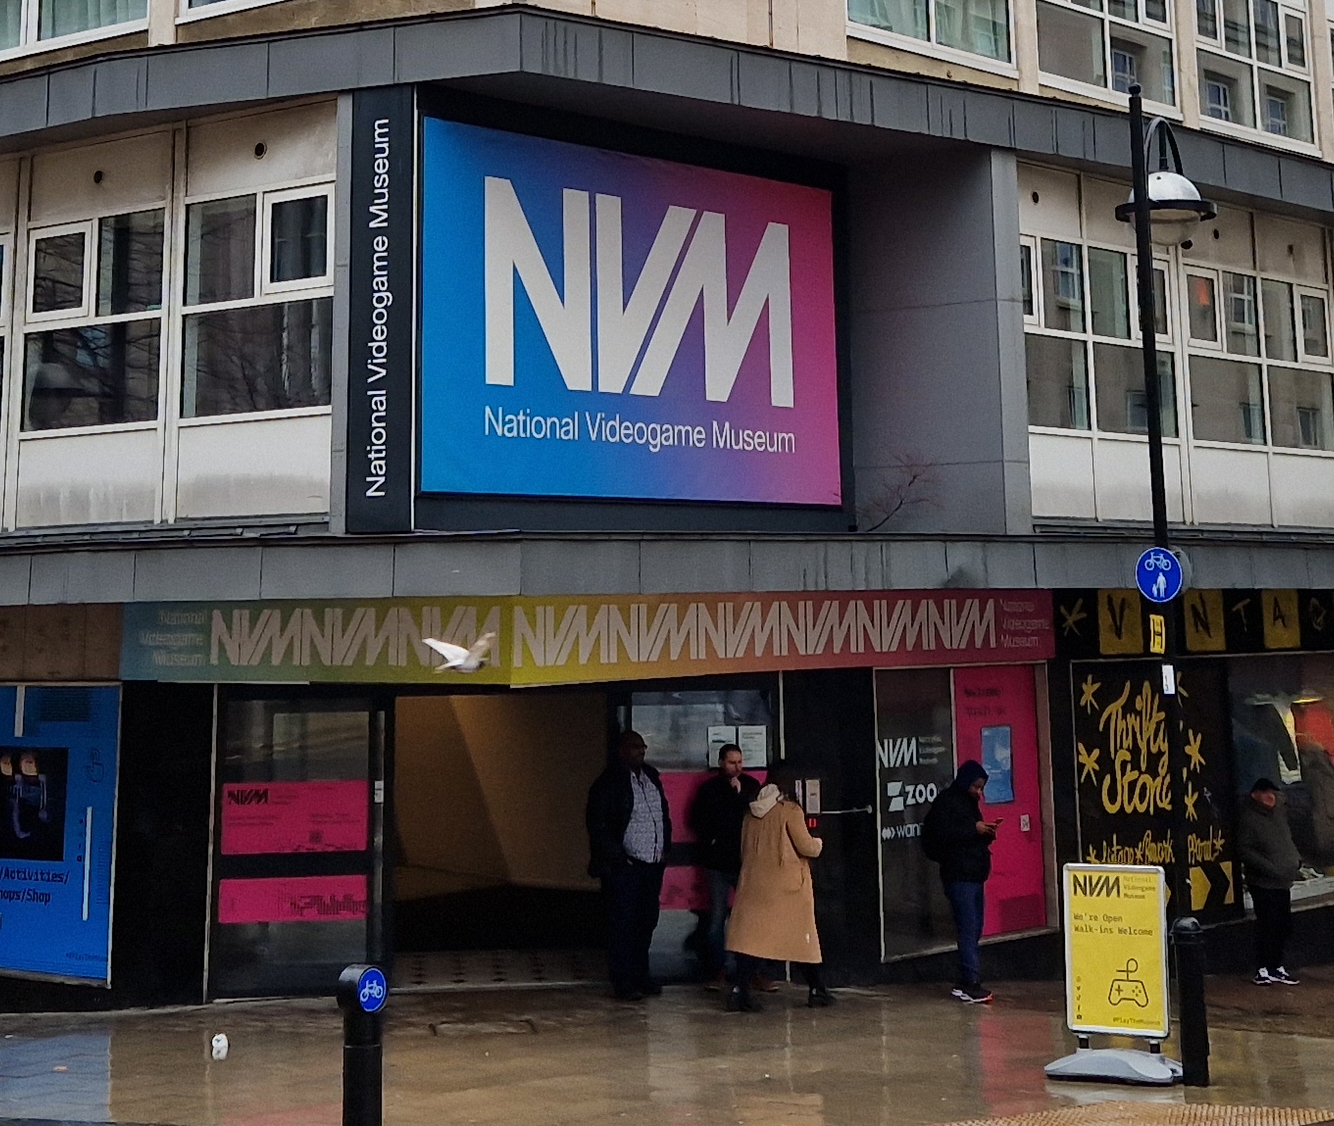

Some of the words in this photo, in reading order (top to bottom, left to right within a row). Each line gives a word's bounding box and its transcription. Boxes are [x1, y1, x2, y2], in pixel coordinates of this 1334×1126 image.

[368, 118, 389, 230] Museum
[367, 234, 393, 384] Videogame
[484, 176, 795, 408] NVM
[366, 390, 386, 498] National
[484, 406, 579, 441] National
[586, 412, 707, 453] Videogame
[712, 420, 795, 454] Museum
[1099, 680, 1169, 776] Thrifty
[227, 788, 269, 806] NVM
[1101, 749, 1172, 815] Store
[1073, 874, 1120, 898] NVM
[1073, 913, 1099, 922] We're
[1102, 914, 1123, 924] Open
[1074, 924, 1114, 934] Walk-ins
[1117, 926, 1154, 937] Welcome
